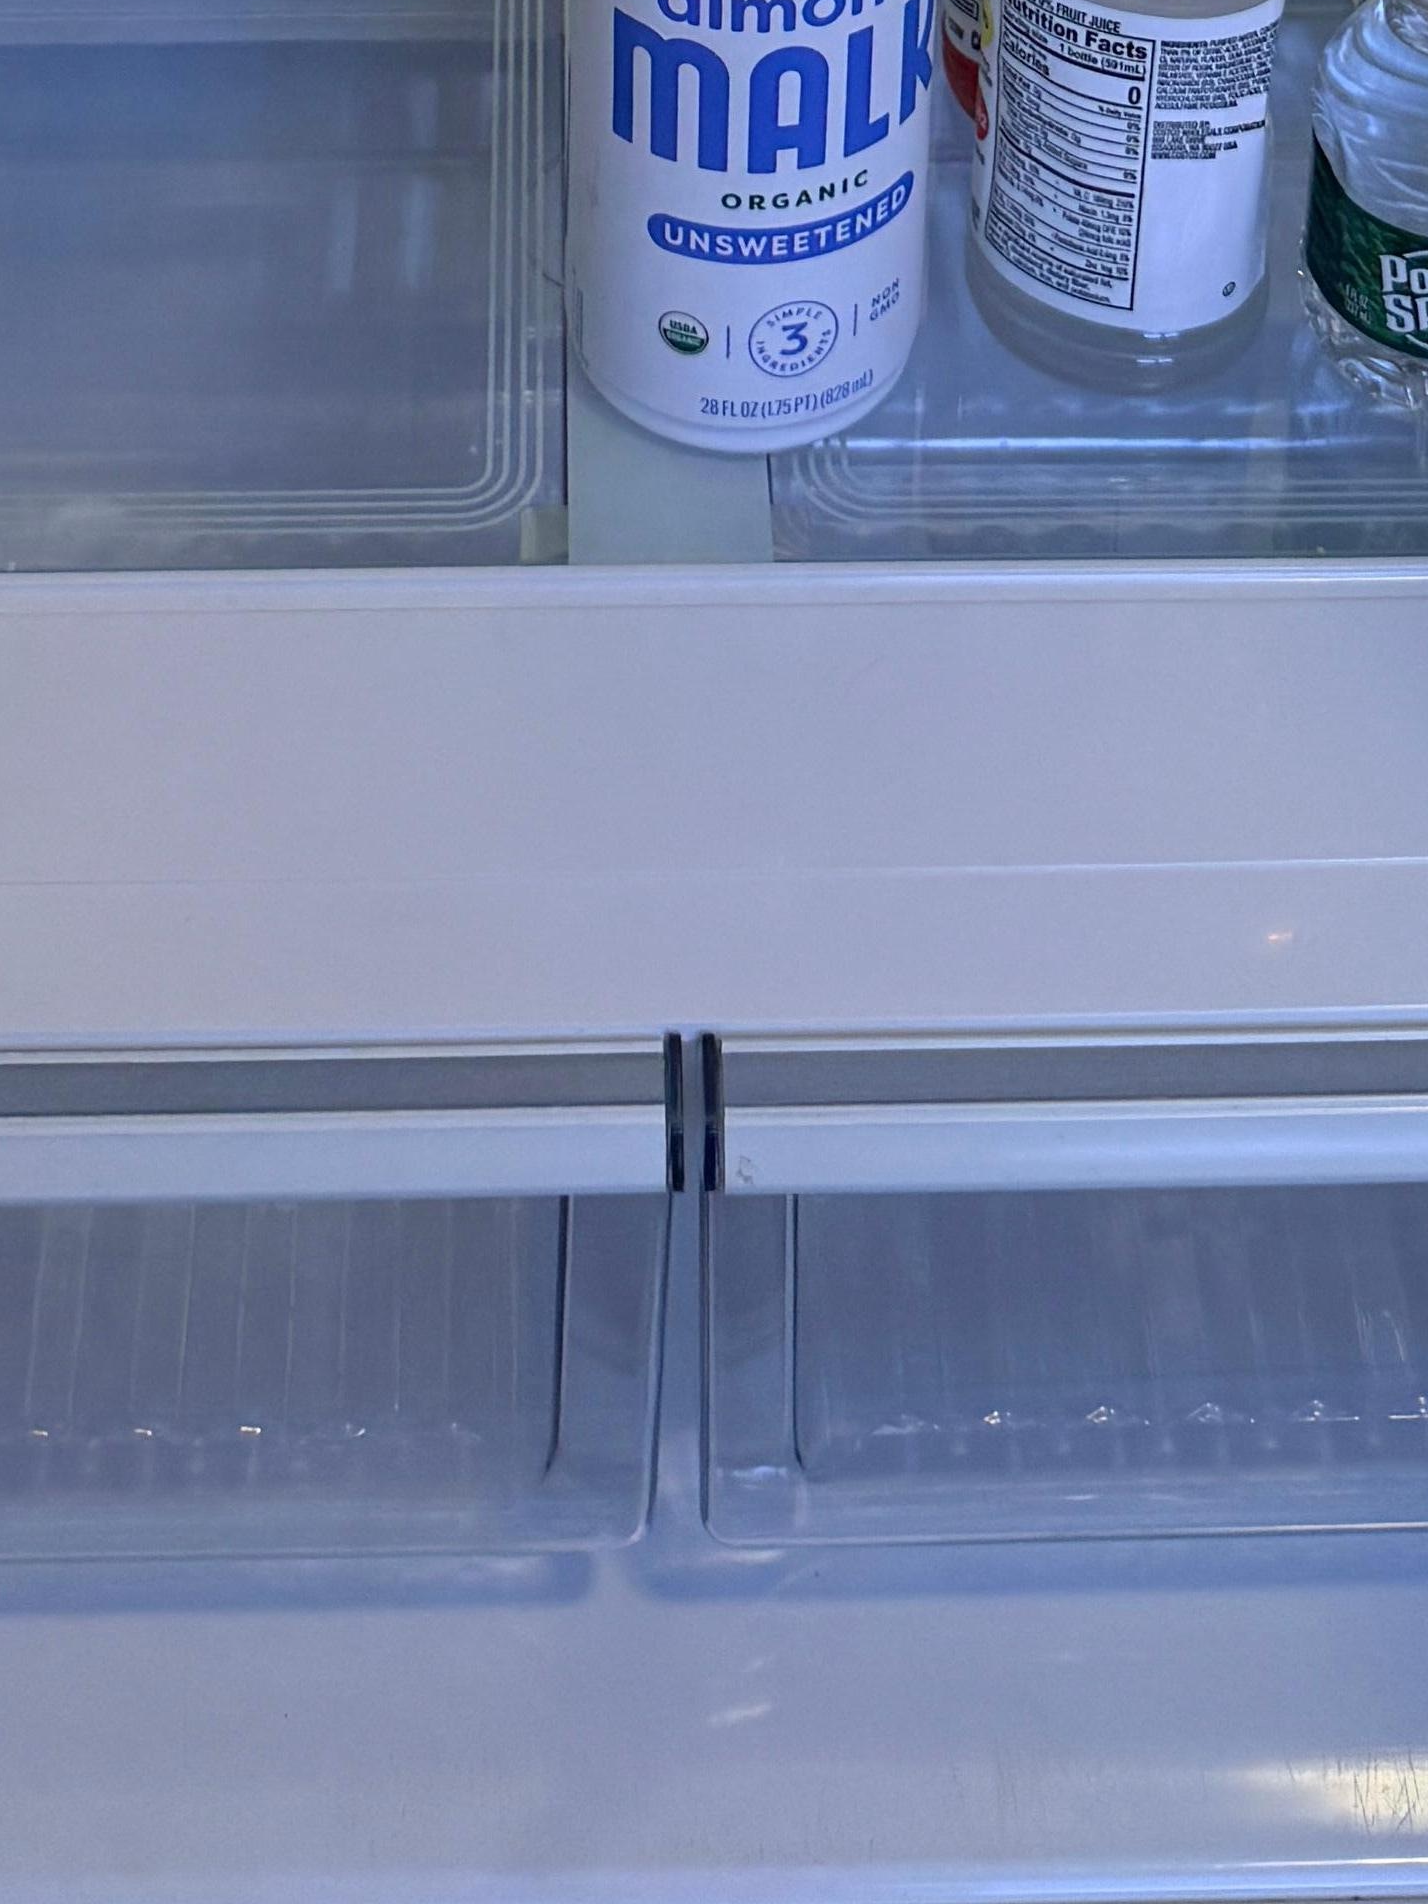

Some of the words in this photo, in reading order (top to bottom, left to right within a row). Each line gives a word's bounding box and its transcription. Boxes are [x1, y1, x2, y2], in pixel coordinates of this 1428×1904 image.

[1084, 30, 1148, 60] Facts
[721, 168, 870, 211] ORGANIC
[662, 183, 907, 257] UNSWEETENED
[766, 306, 822, 328] SIMPLE
[780, 321, 808, 356] 3
[700, 397, 719, 416] 28
